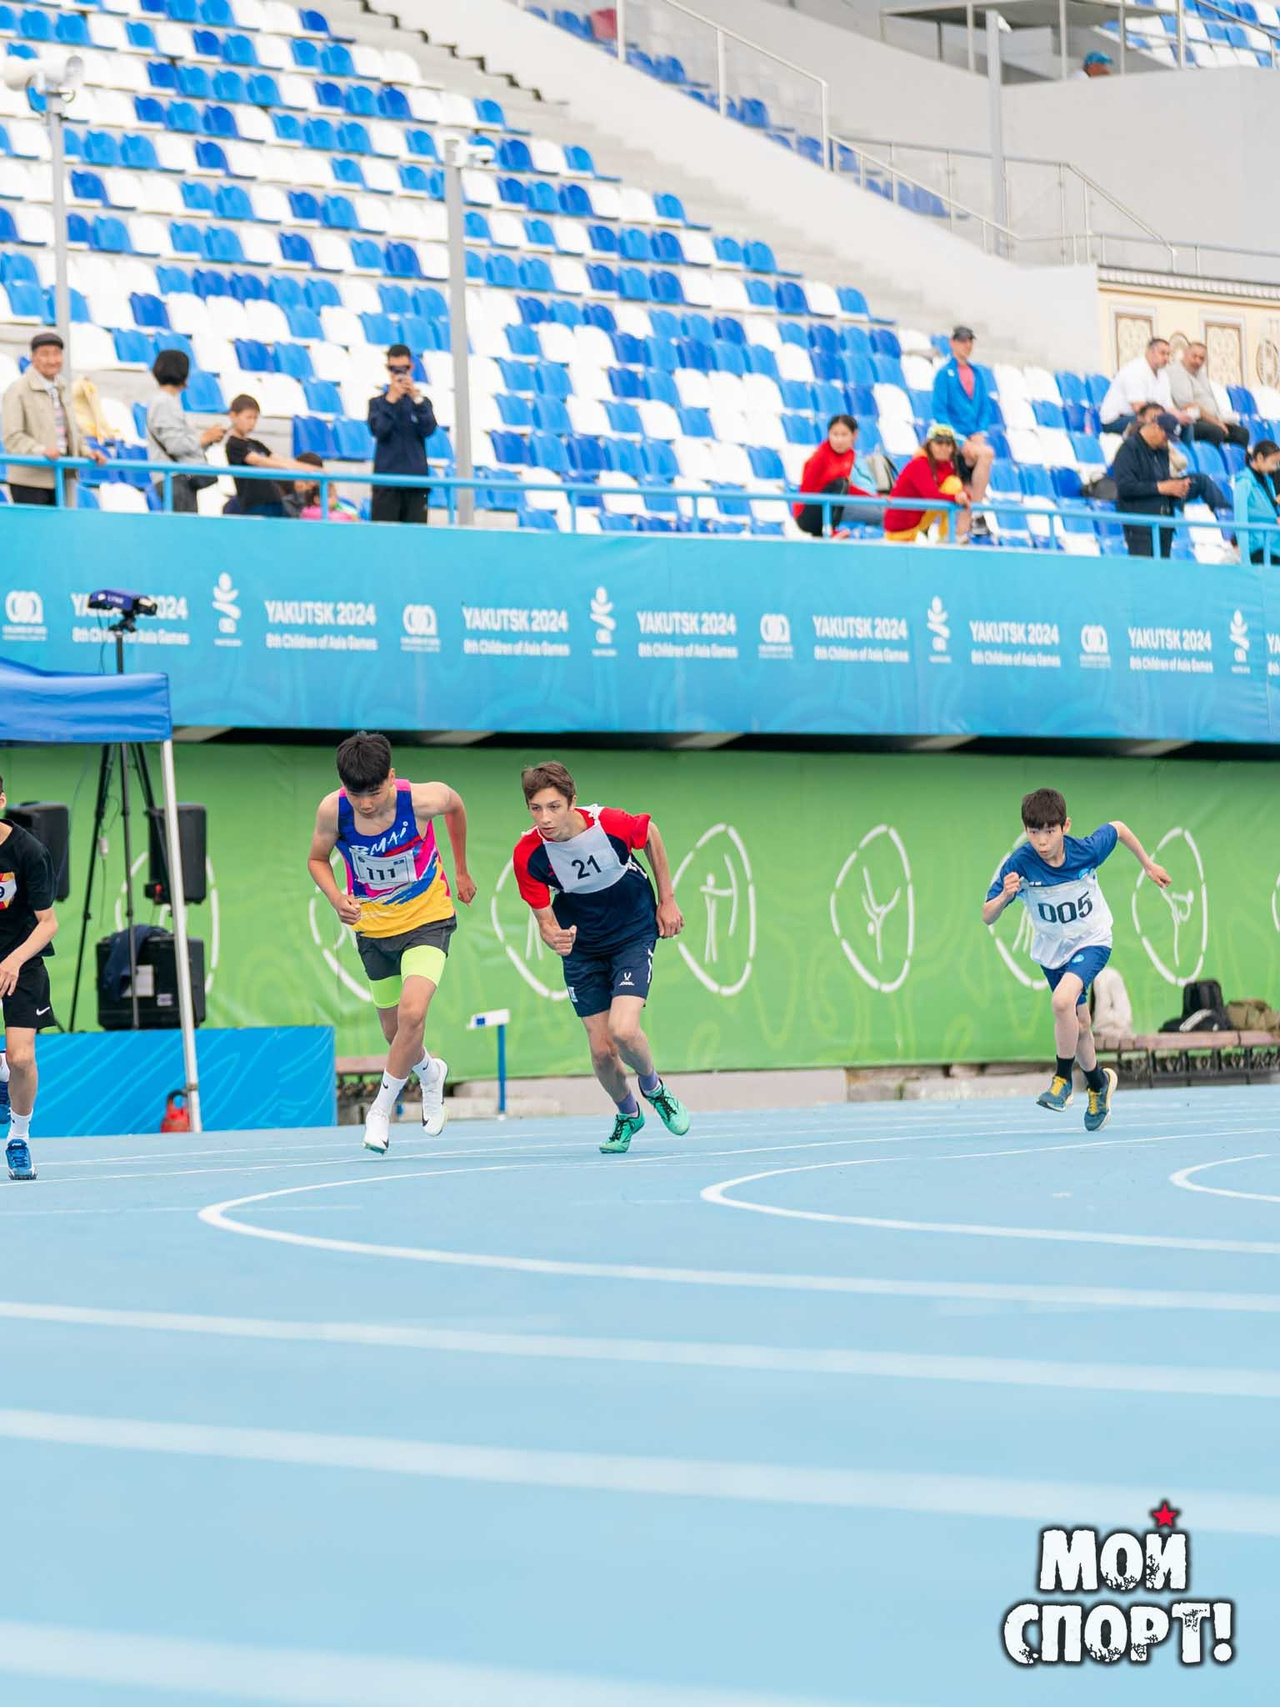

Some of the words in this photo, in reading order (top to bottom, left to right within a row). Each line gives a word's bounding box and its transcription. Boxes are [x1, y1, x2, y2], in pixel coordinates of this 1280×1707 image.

[263, 599, 335, 625] YAKUTSK
[336, 601, 377, 626] 2024
[462, 606, 530, 632] YAKUTSK
[531, 608, 568, 633] 2024
[636, 611, 699, 635] YAKUTSK
[700, 612, 737, 636] 2024
[812, 615, 873, 640] YAKUTSK
[874, 616, 908, 641] 2024
[968, 620, 1027, 645] YAKUTSK
[1027, 622, 1060, 646] 2024
[1127, 626, 1181, 651] YAKUTSK
[1182, 628, 1213, 653] 2024
[367, 867, 396, 880] 111
[571, 855, 602, 880] 21
[1038, 891, 1093, 924] 005
